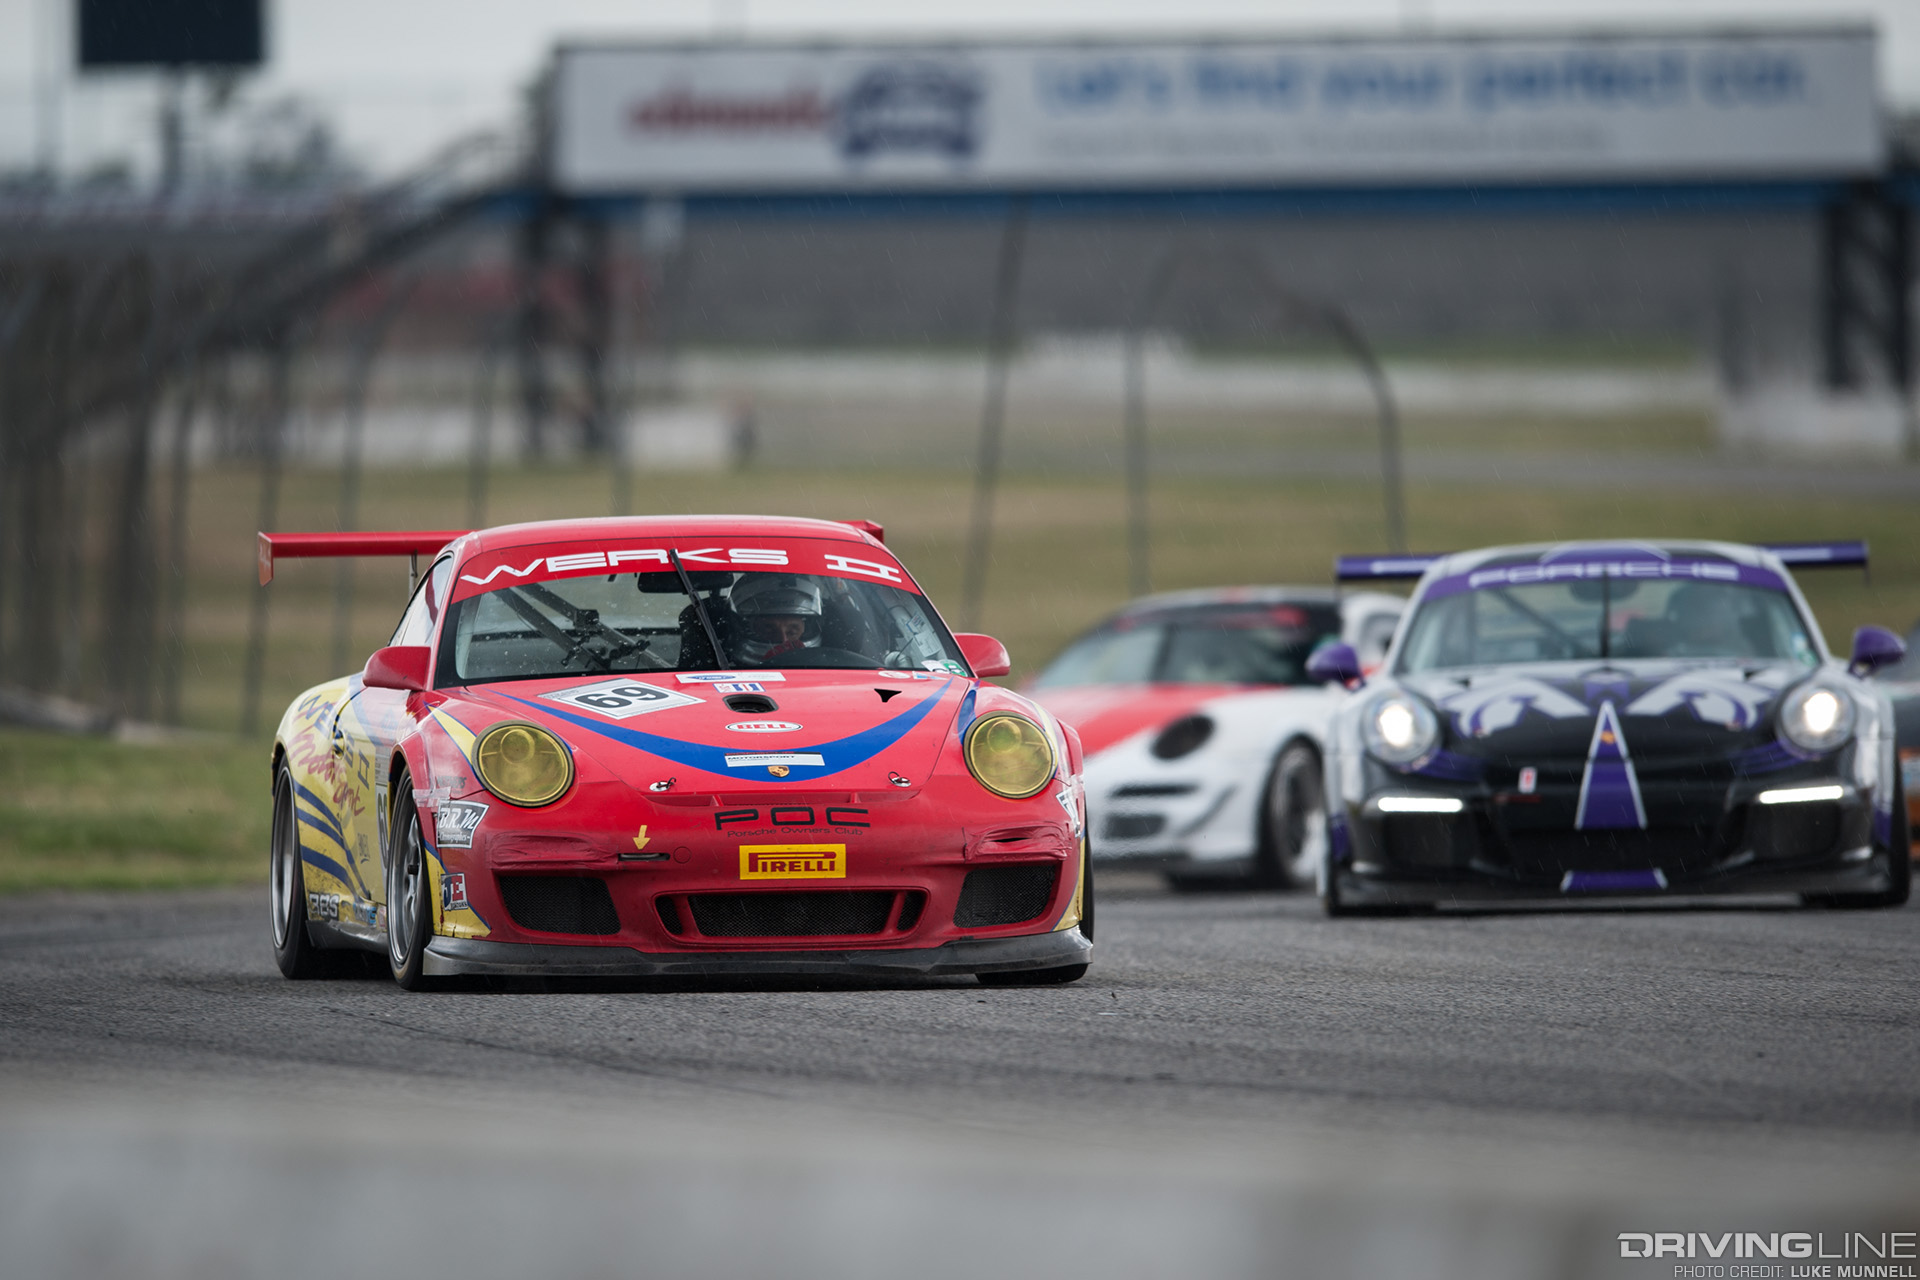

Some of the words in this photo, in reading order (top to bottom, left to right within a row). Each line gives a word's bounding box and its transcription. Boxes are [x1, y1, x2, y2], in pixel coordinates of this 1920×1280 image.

[460, 548, 788, 585] WERKS
[1469, 562, 1740, 588] PORSCHE
[575, 687, 670, 708] 69
[715, 807, 871, 830] POC
[727, 829, 777, 838] Porsche
[781, 827, 831, 835] Owners
[835, 827, 863, 836] Club
[748, 852, 837, 873] PIRELLI
[309, 892, 340, 919] BBS
